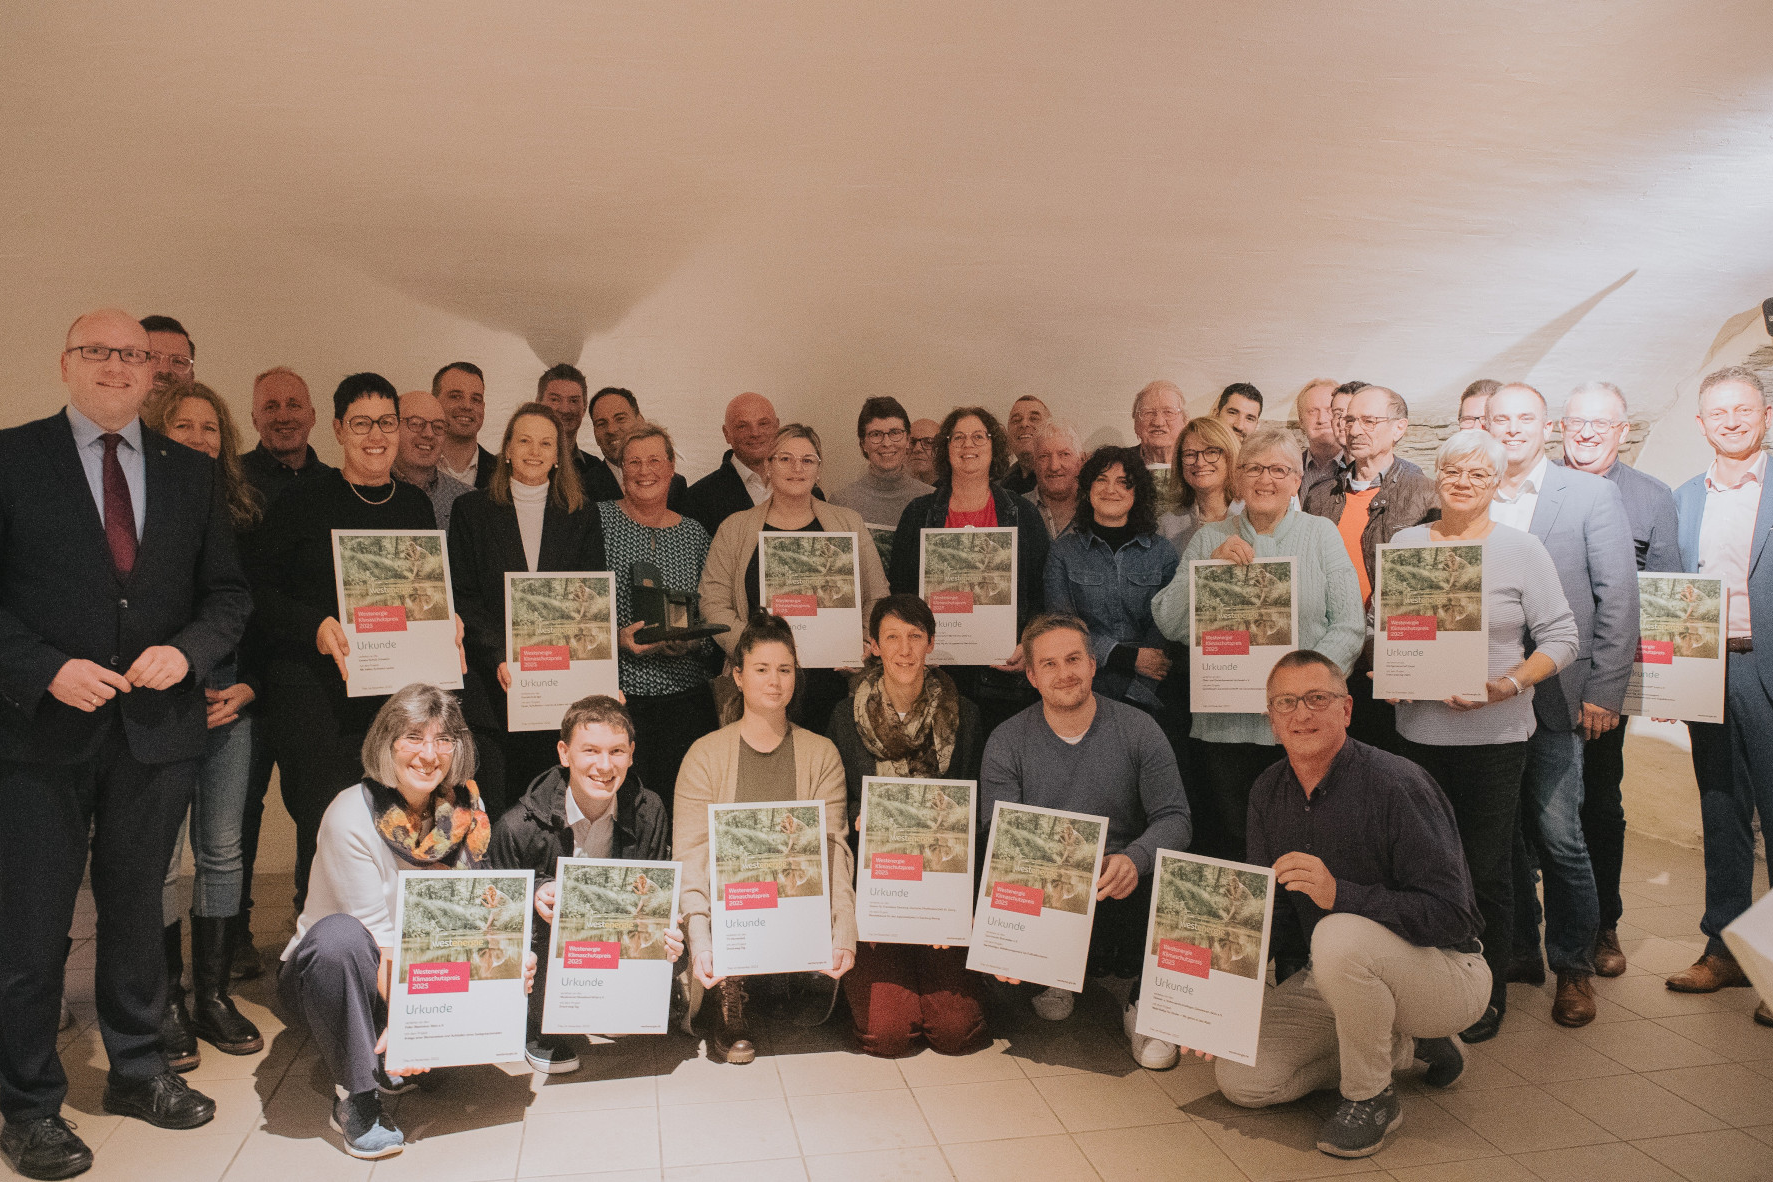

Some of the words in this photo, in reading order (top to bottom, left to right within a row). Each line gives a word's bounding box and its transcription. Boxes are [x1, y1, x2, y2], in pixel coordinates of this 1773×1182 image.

[935, 620, 962, 628] kunde
[357, 640, 397, 650] Urkunde
[1386, 648, 1424, 657] Urkunde
[1202, 663, 1238, 671] Urkunde
[1632, 669, 1660, 678] kunde
[520, 679, 559, 687] Urkunde
[869, 887, 909, 897] Urkunde
[996, 886, 1026, 897] Westenergie
[587, 921, 634, 929] westenergie
[725, 918, 766, 928] Urkunde
[987, 916, 1026, 931] Urkunde
[431, 939, 484, 948] westenergie
[568, 945, 601, 953] Westenergie
[1163, 944, 1193, 956] Westenergie
[1161, 958, 1176, 966] 2025
[412, 975, 461, 983] Klimaschutzpreis
[561, 977, 604, 987] Urkunde
[1155, 976, 1194, 995] Urkunde
[406, 1003, 453, 1015] Urkunde
